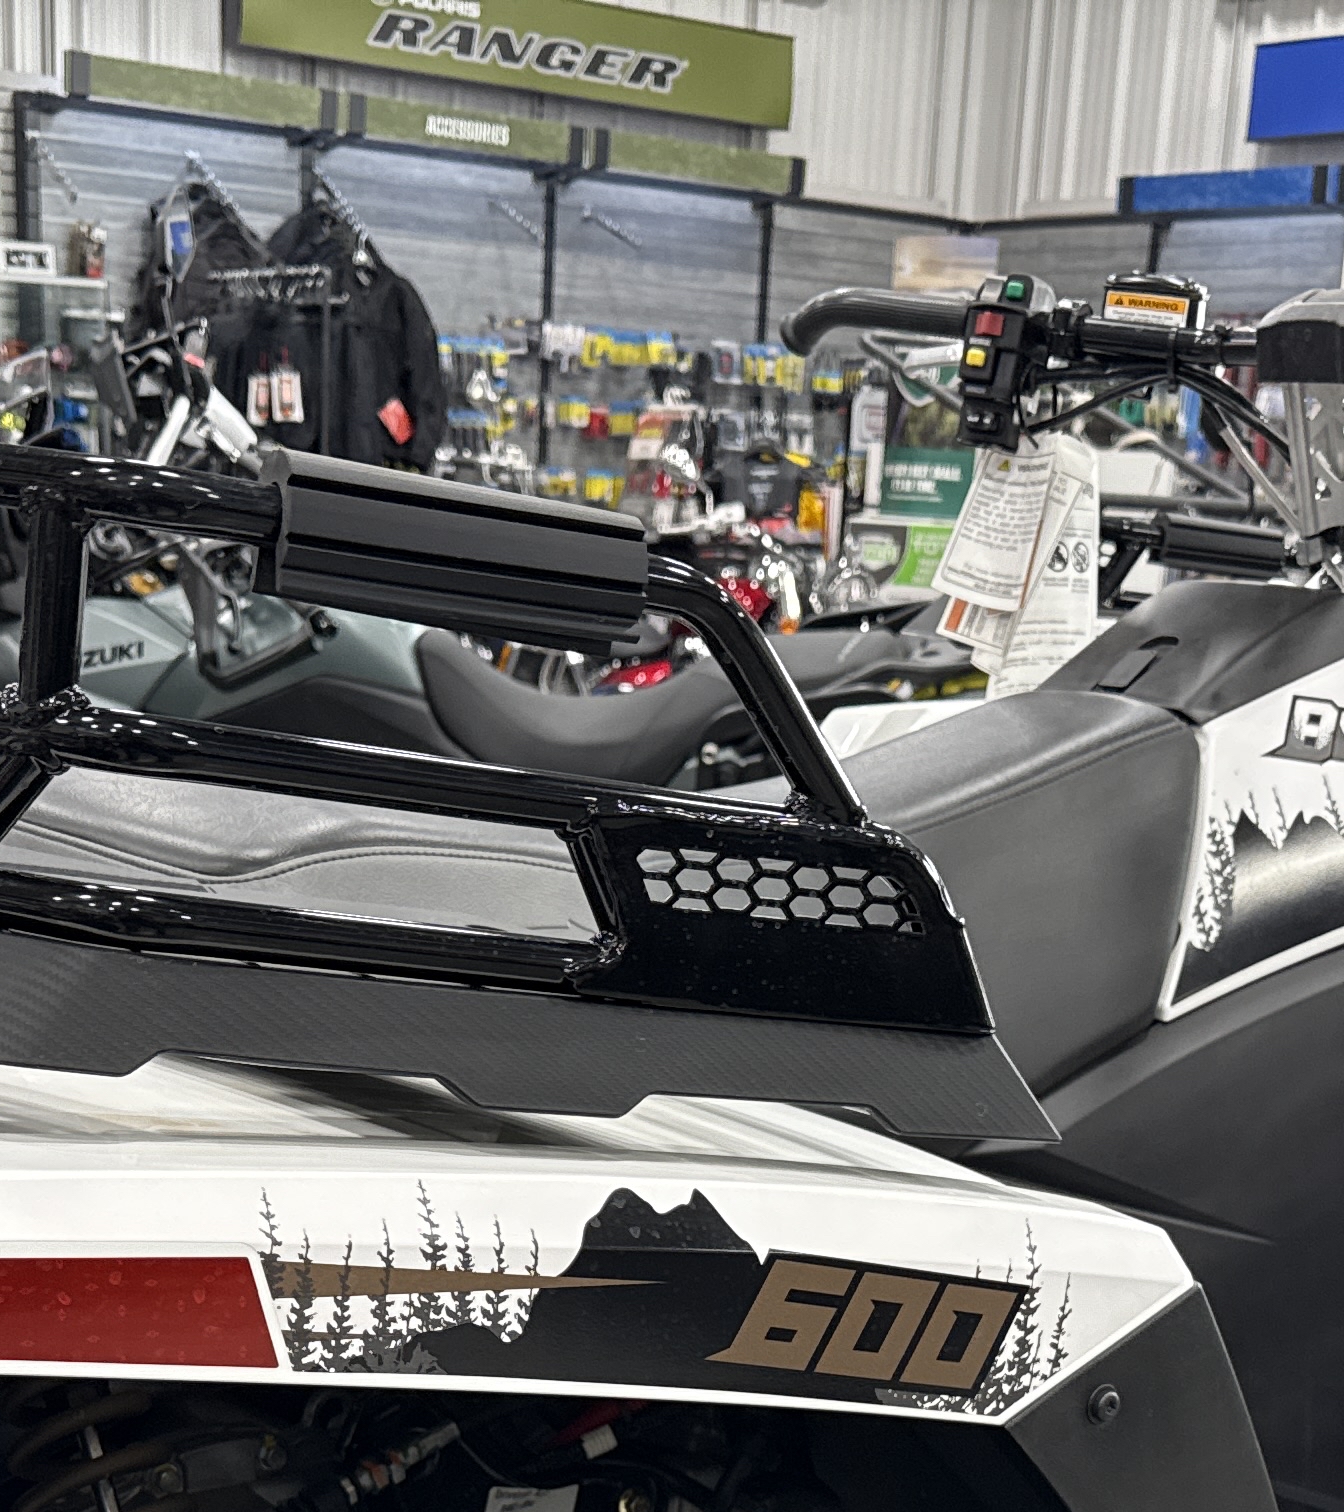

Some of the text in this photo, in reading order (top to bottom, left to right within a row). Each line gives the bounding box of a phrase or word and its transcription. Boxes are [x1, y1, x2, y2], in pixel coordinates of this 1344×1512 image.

[367, 8, 682, 93] RANGER
[425, 114, 510, 146] ACCESSORIES
[1128, 298, 1179, 311] WARNING
[83, 640, 145, 669] ZUKI
[703, 1259, 1019, 1389] 600
